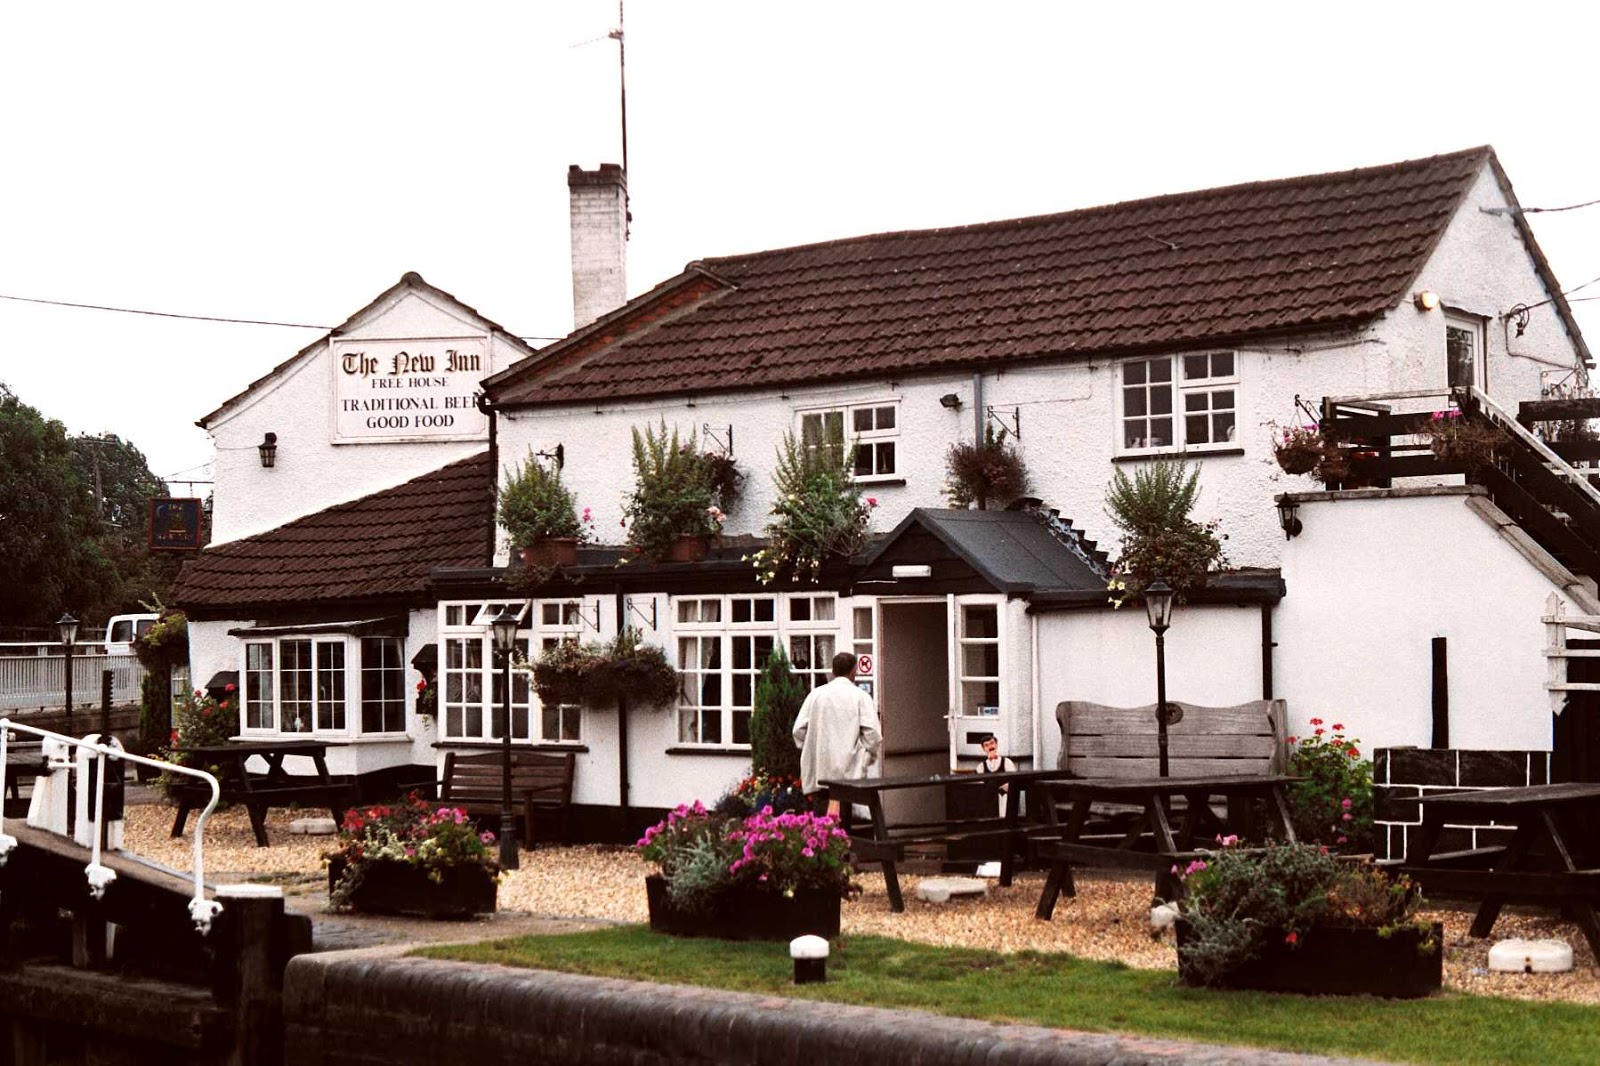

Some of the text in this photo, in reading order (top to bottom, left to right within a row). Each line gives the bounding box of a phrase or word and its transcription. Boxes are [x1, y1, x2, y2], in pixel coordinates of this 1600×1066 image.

[342, 350, 480, 378] The New Inn
[372, 377, 449, 388] FREE HOUSE
[341, 397, 438, 411] TRADITIONAL
[367, 415, 454, 428] GOOD FOOD
